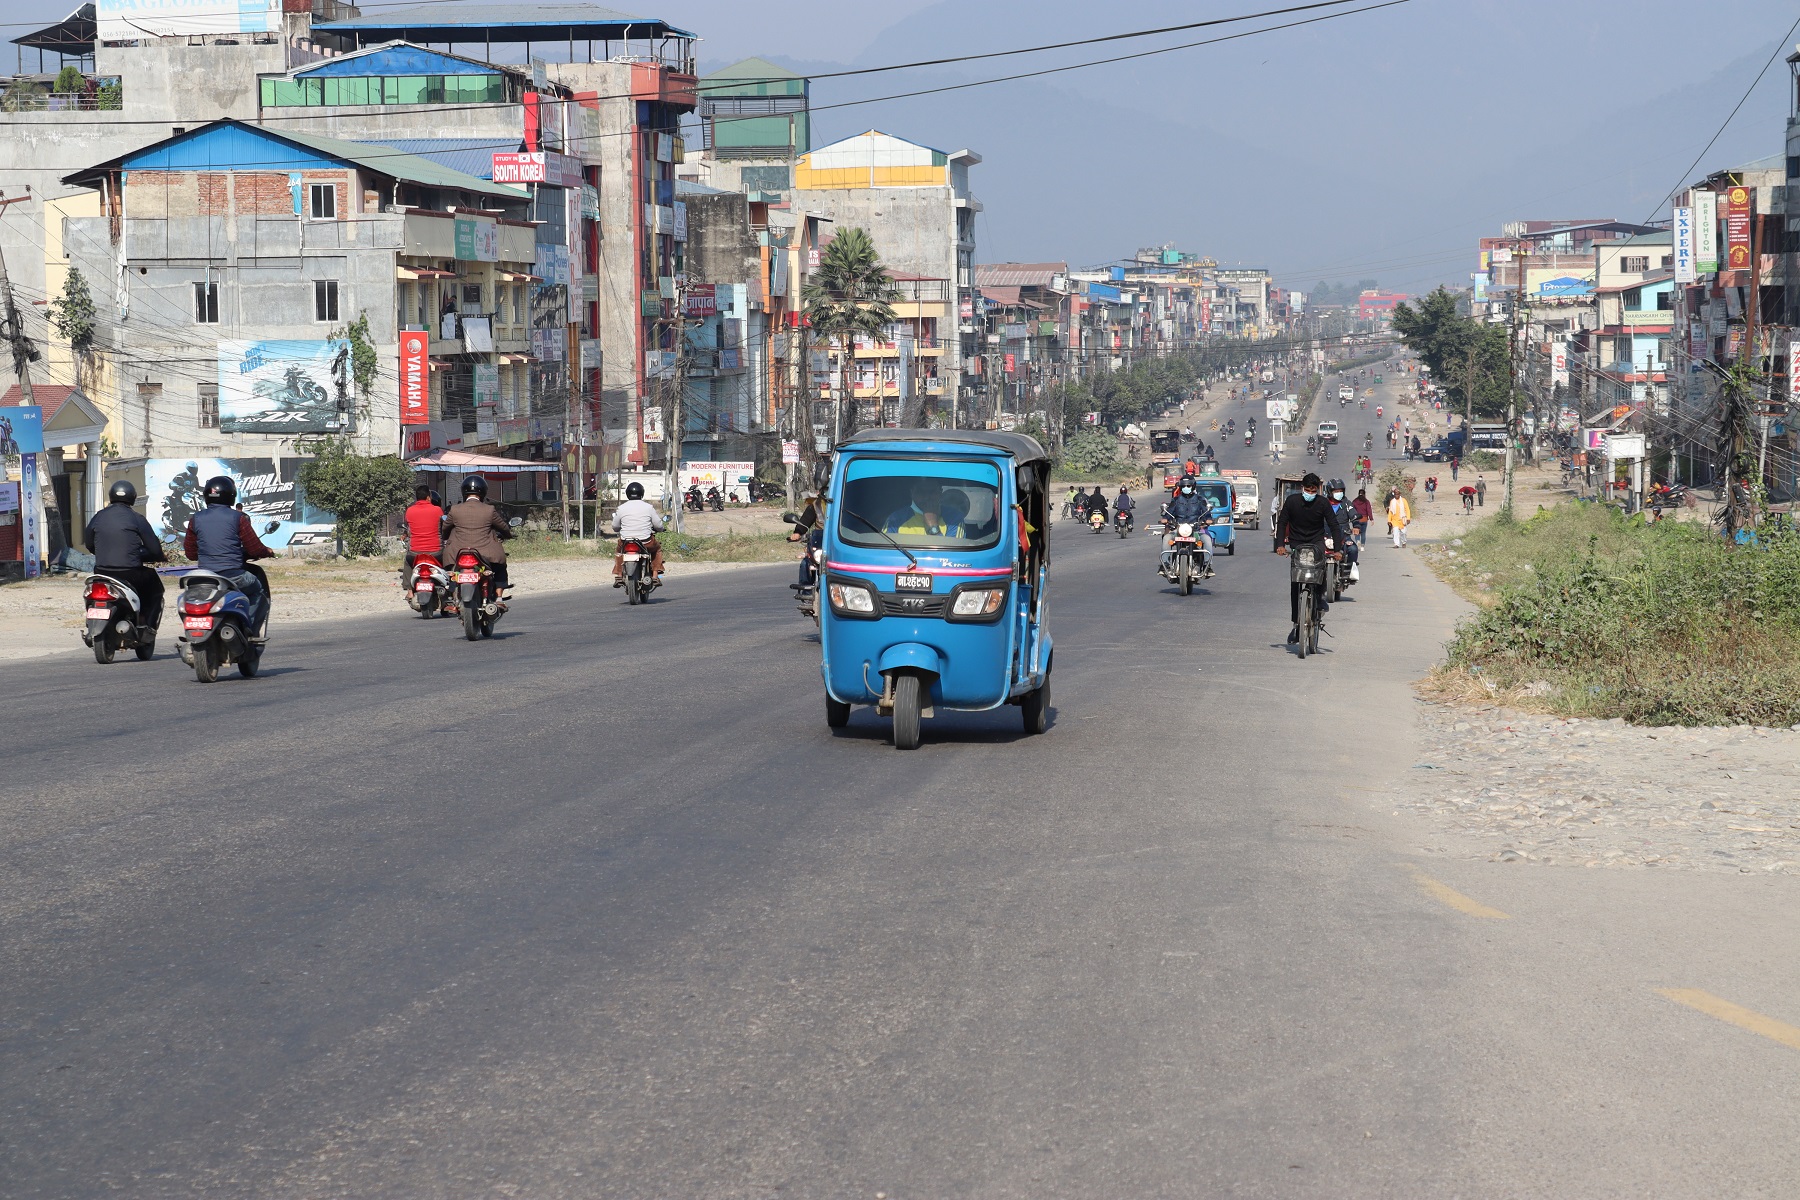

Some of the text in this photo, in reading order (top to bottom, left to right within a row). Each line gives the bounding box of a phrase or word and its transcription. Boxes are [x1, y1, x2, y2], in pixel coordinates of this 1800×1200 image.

[495, 165, 518, 181] SOUTH
[520, 164, 543, 181] KOREA
[1678, 208, 1689, 267] EXPERT
[407, 356, 422, 408] YAMAHA
[260, 411, 310, 422] ZR
[902, 598, 925, 607] TVS
